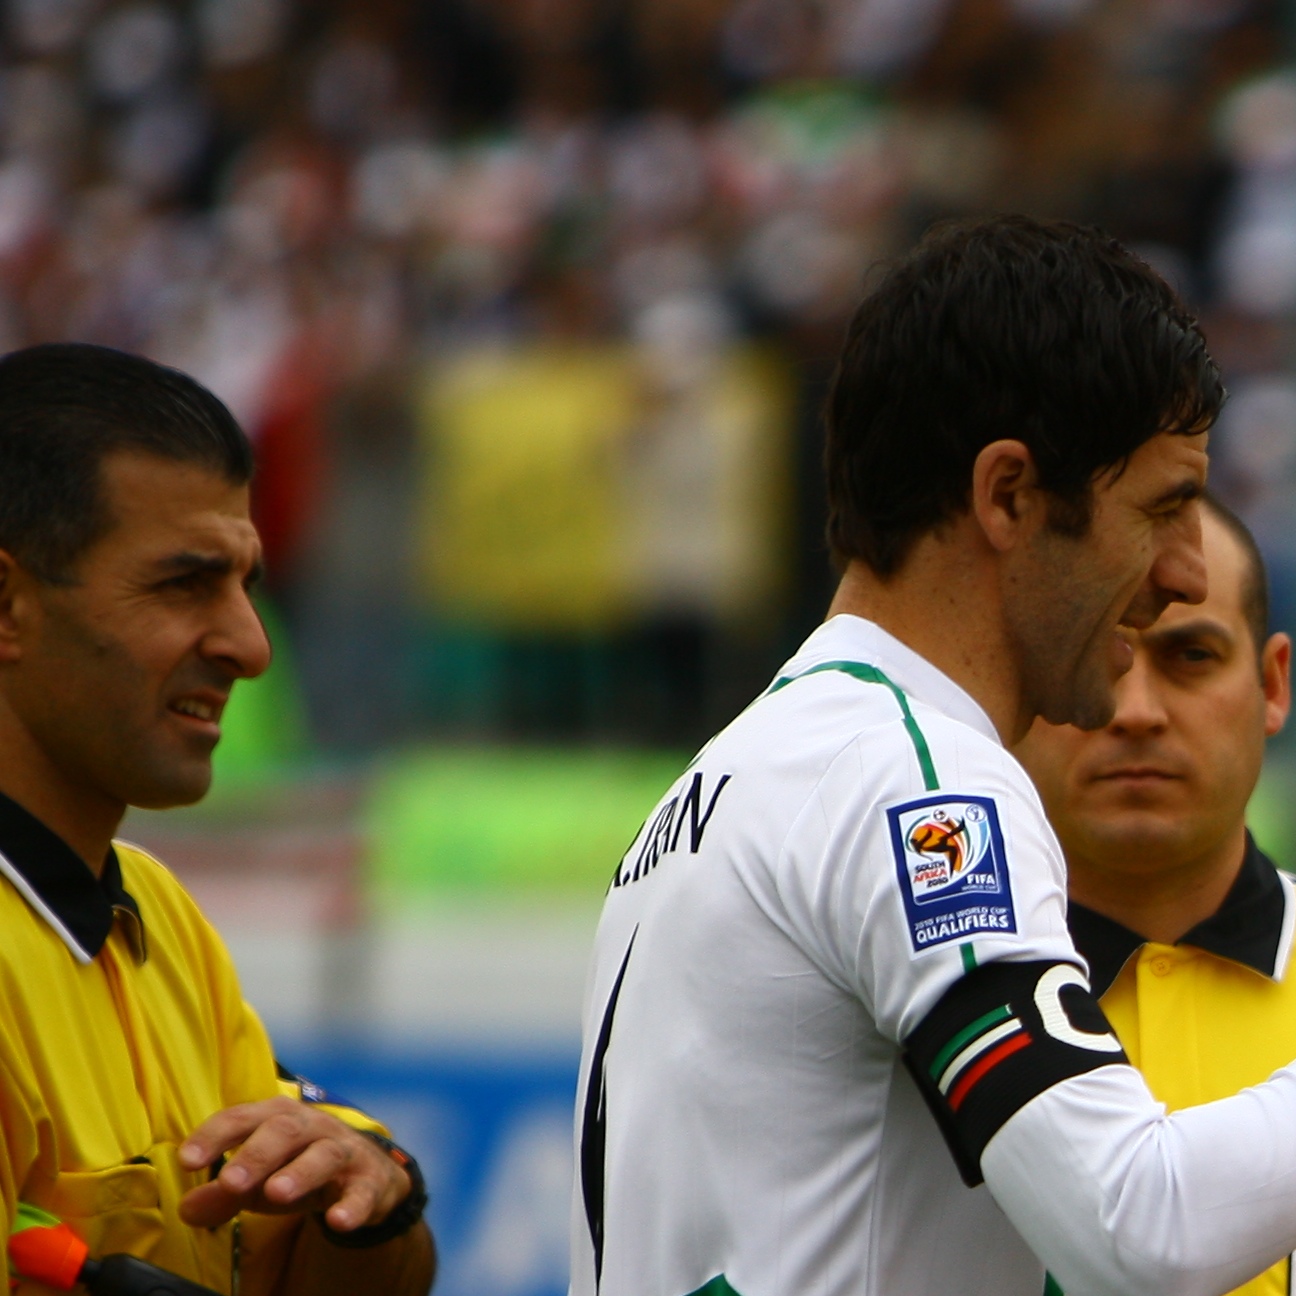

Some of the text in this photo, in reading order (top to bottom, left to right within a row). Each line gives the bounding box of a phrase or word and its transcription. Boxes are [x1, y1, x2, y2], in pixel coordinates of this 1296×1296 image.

[914, 860, 946, 873] SOUTH
[913, 869, 947, 884] AFRICA
[927, 877, 949, 889] 2010
[966, 873, 996, 885] FIFA
[935, 913, 956, 924] FIFA
[957, 906, 988, 918] WORLD
[989, 905, 1008, 916] CUP
[916, 914, 1009, 944] QUALIFIERS
[1033, 963, 1122, 1053] C
